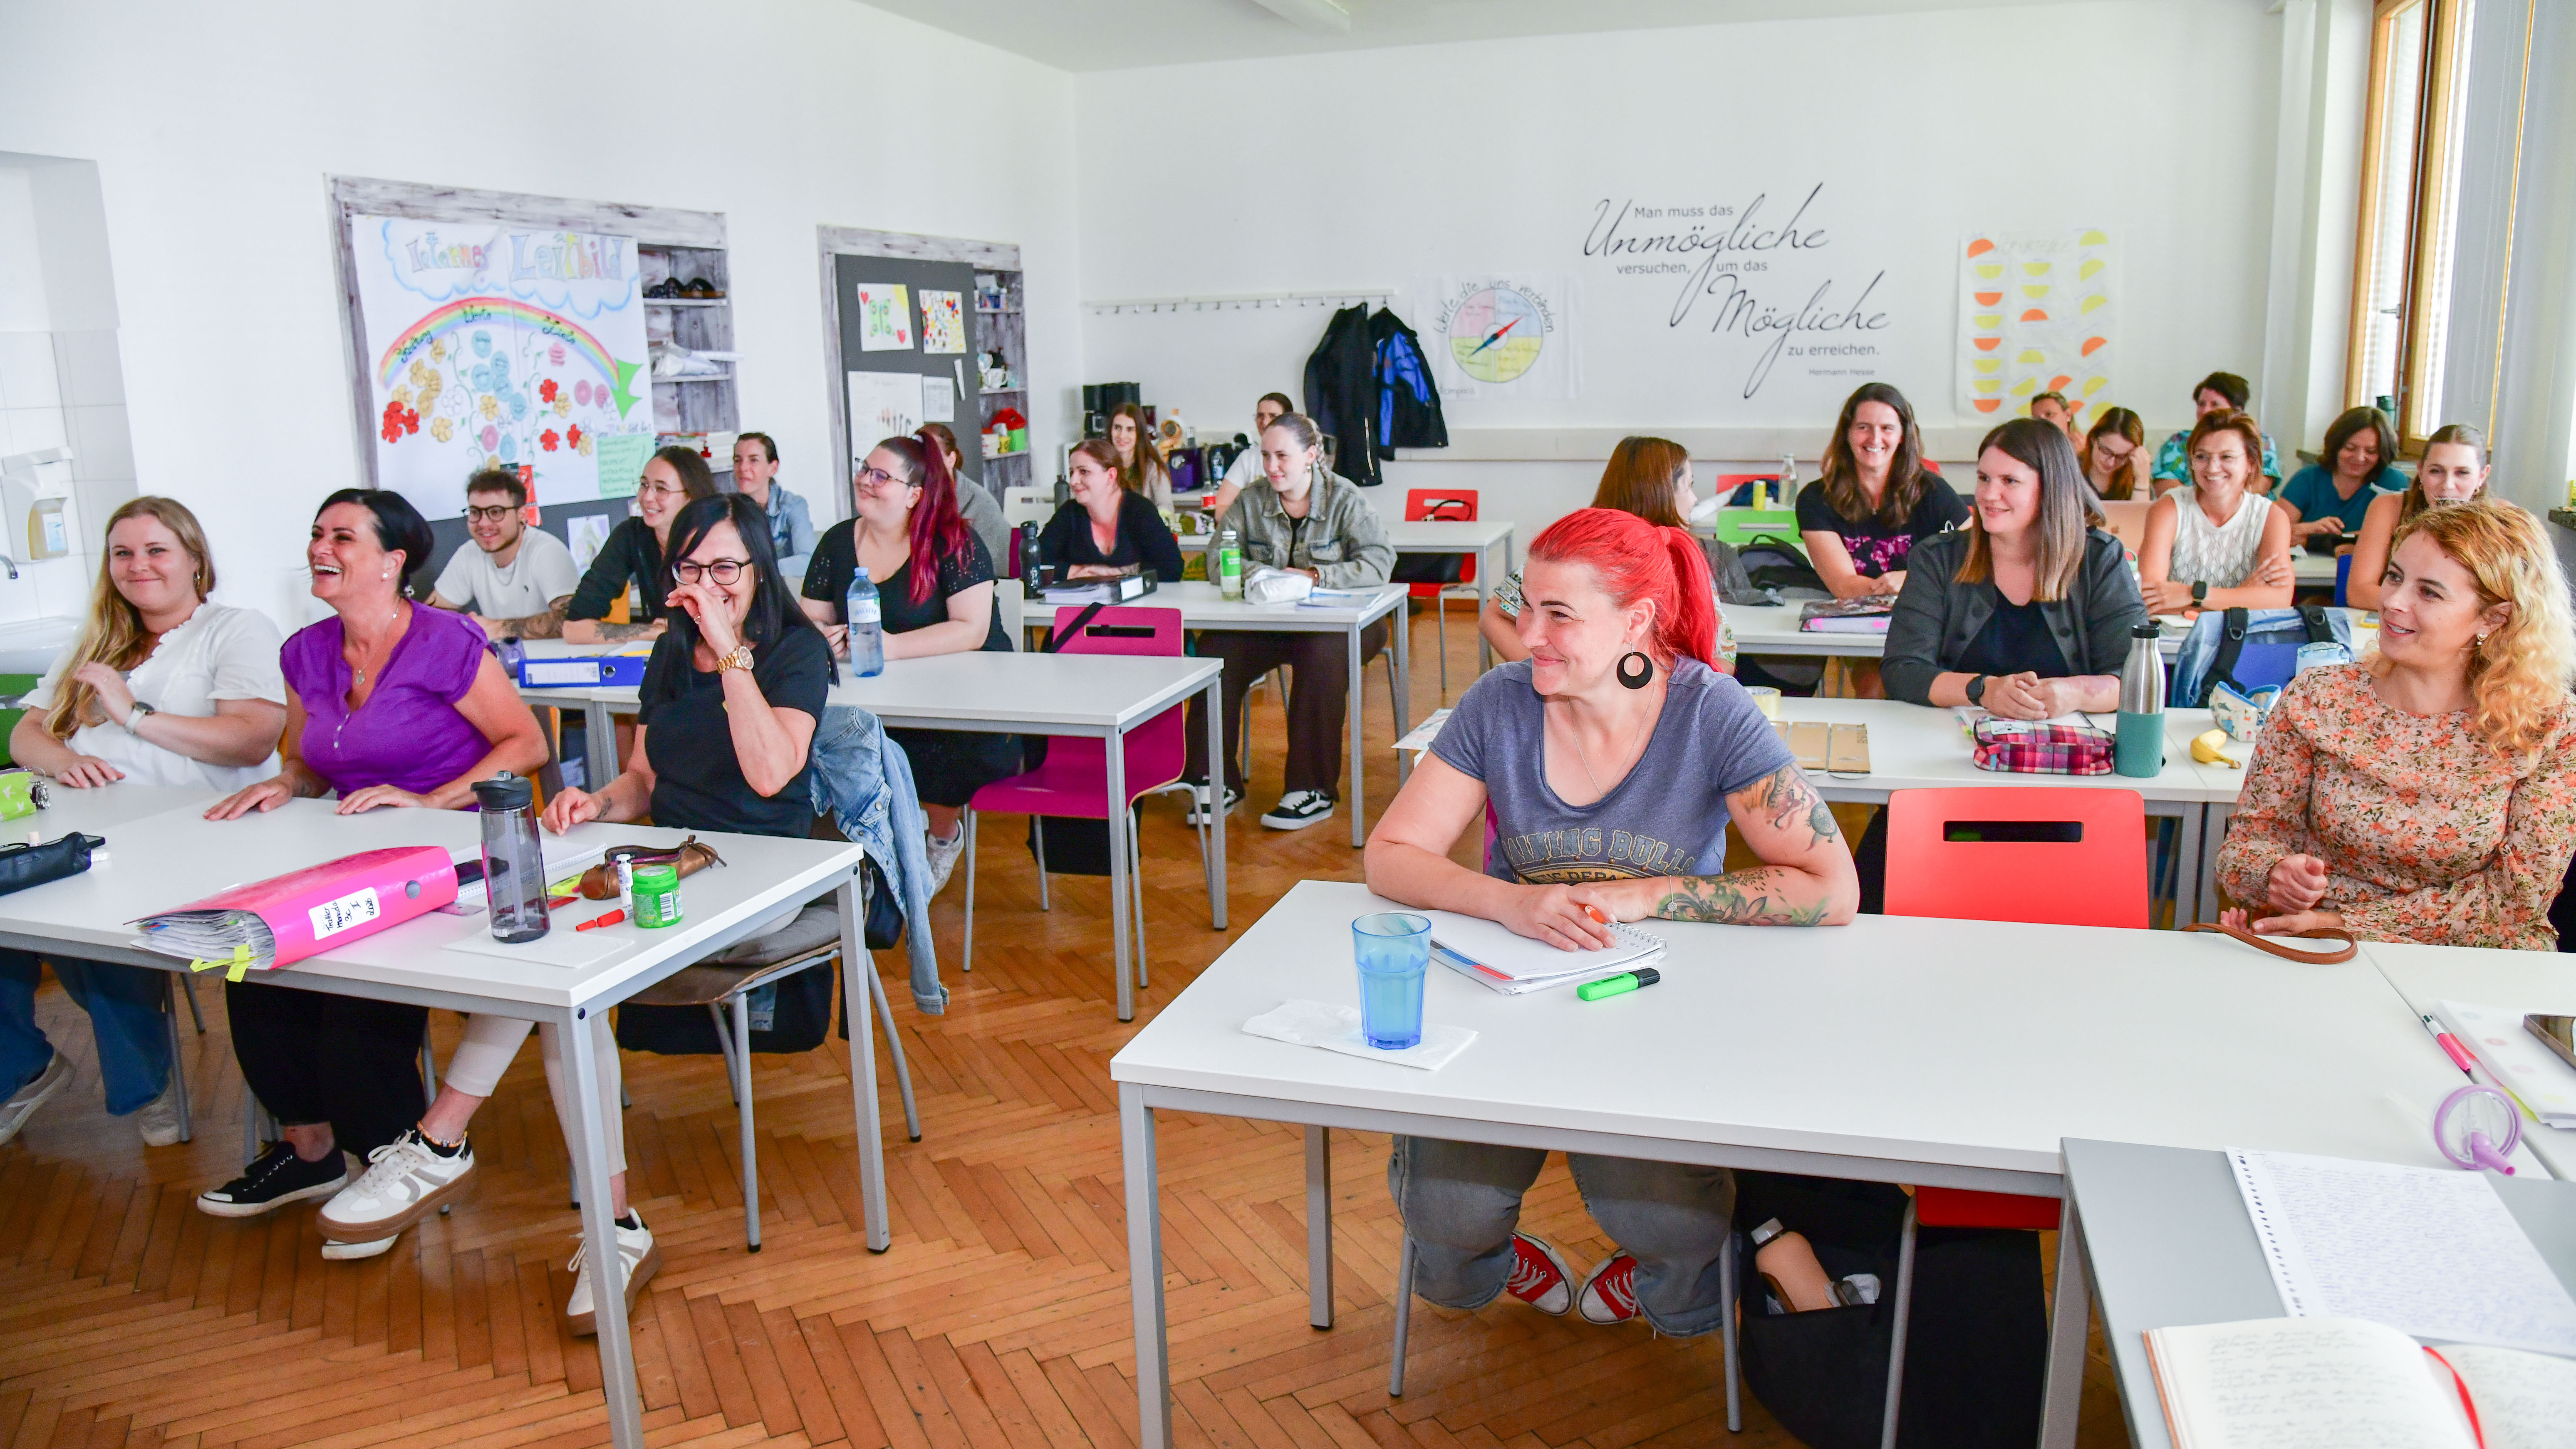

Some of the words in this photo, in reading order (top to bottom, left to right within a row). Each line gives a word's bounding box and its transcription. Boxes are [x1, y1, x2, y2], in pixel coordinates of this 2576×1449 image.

[1635, 206, 1663, 219] Man
[1667, 207, 1704, 218] muss
[1709, 204, 1734, 217] das
[509, 232, 623, 282] Leitbild
[1584, 182, 1830, 327] Unmögliche
[1616, 261, 1691, 275] versuchen,
[1716, 262, 1738, 272] um
[1744, 259, 1768, 272] das
[1460, 282, 1479, 299] die
[1489, 279, 1511, 289] uns
[1707, 270, 1891, 399] Mögliche
[1787, 345, 1803, 356] zu
[1809, 344, 1880, 356] erreichen.
